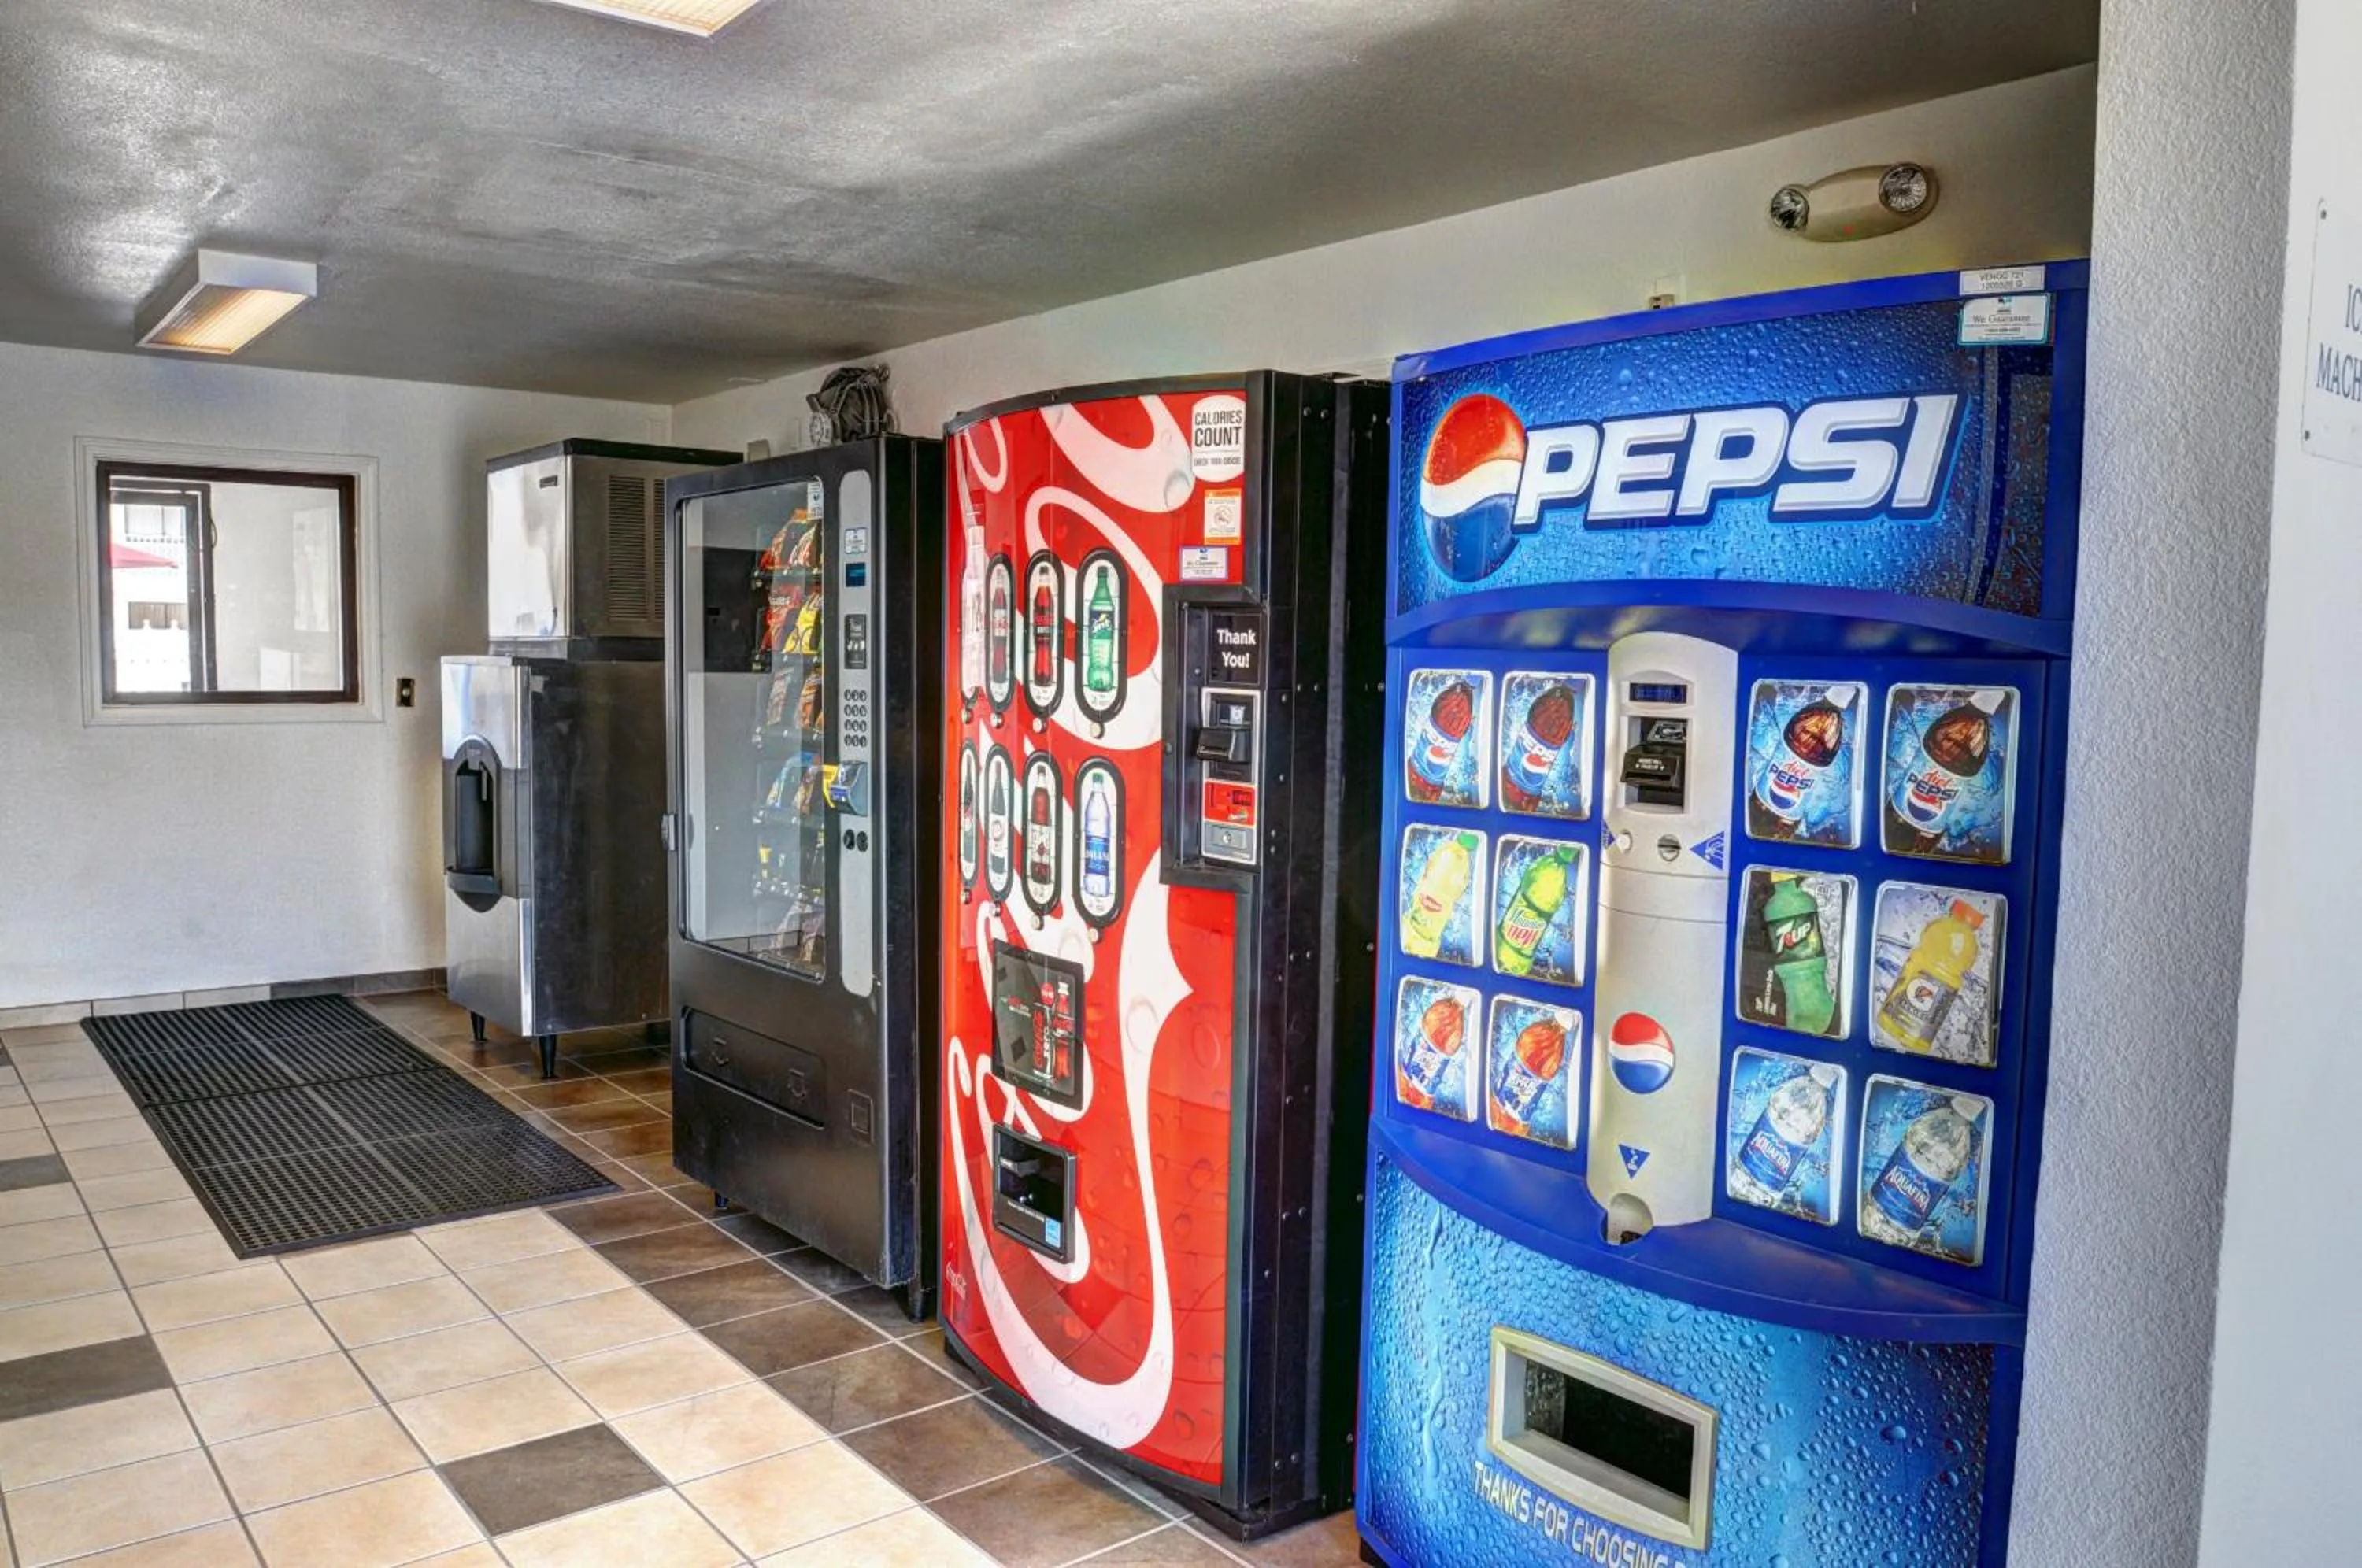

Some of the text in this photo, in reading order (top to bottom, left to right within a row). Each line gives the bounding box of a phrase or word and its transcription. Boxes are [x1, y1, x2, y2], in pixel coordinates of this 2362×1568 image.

[1194, 410, 1242, 426] CALORIES
[1194, 427, 1242, 447] COUNT
[1511, 392, 1960, 527] PEPSI
[1216, 628, 1257, 645] Thank
[1222, 651, 1250, 668] You!
[1769, 763, 1815, 790] PEPSI
[1906, 772, 1959, 801] PEPSI
[1775, 919, 1811, 955] 7UP
[1749, 1132, 1789, 1175] AQUAFINA
[1883, 1164, 1929, 1213] AQUAFINA
[1474, 1460, 1532, 1524] THANKS
[1533, 1498, 1570, 1544] FOR
